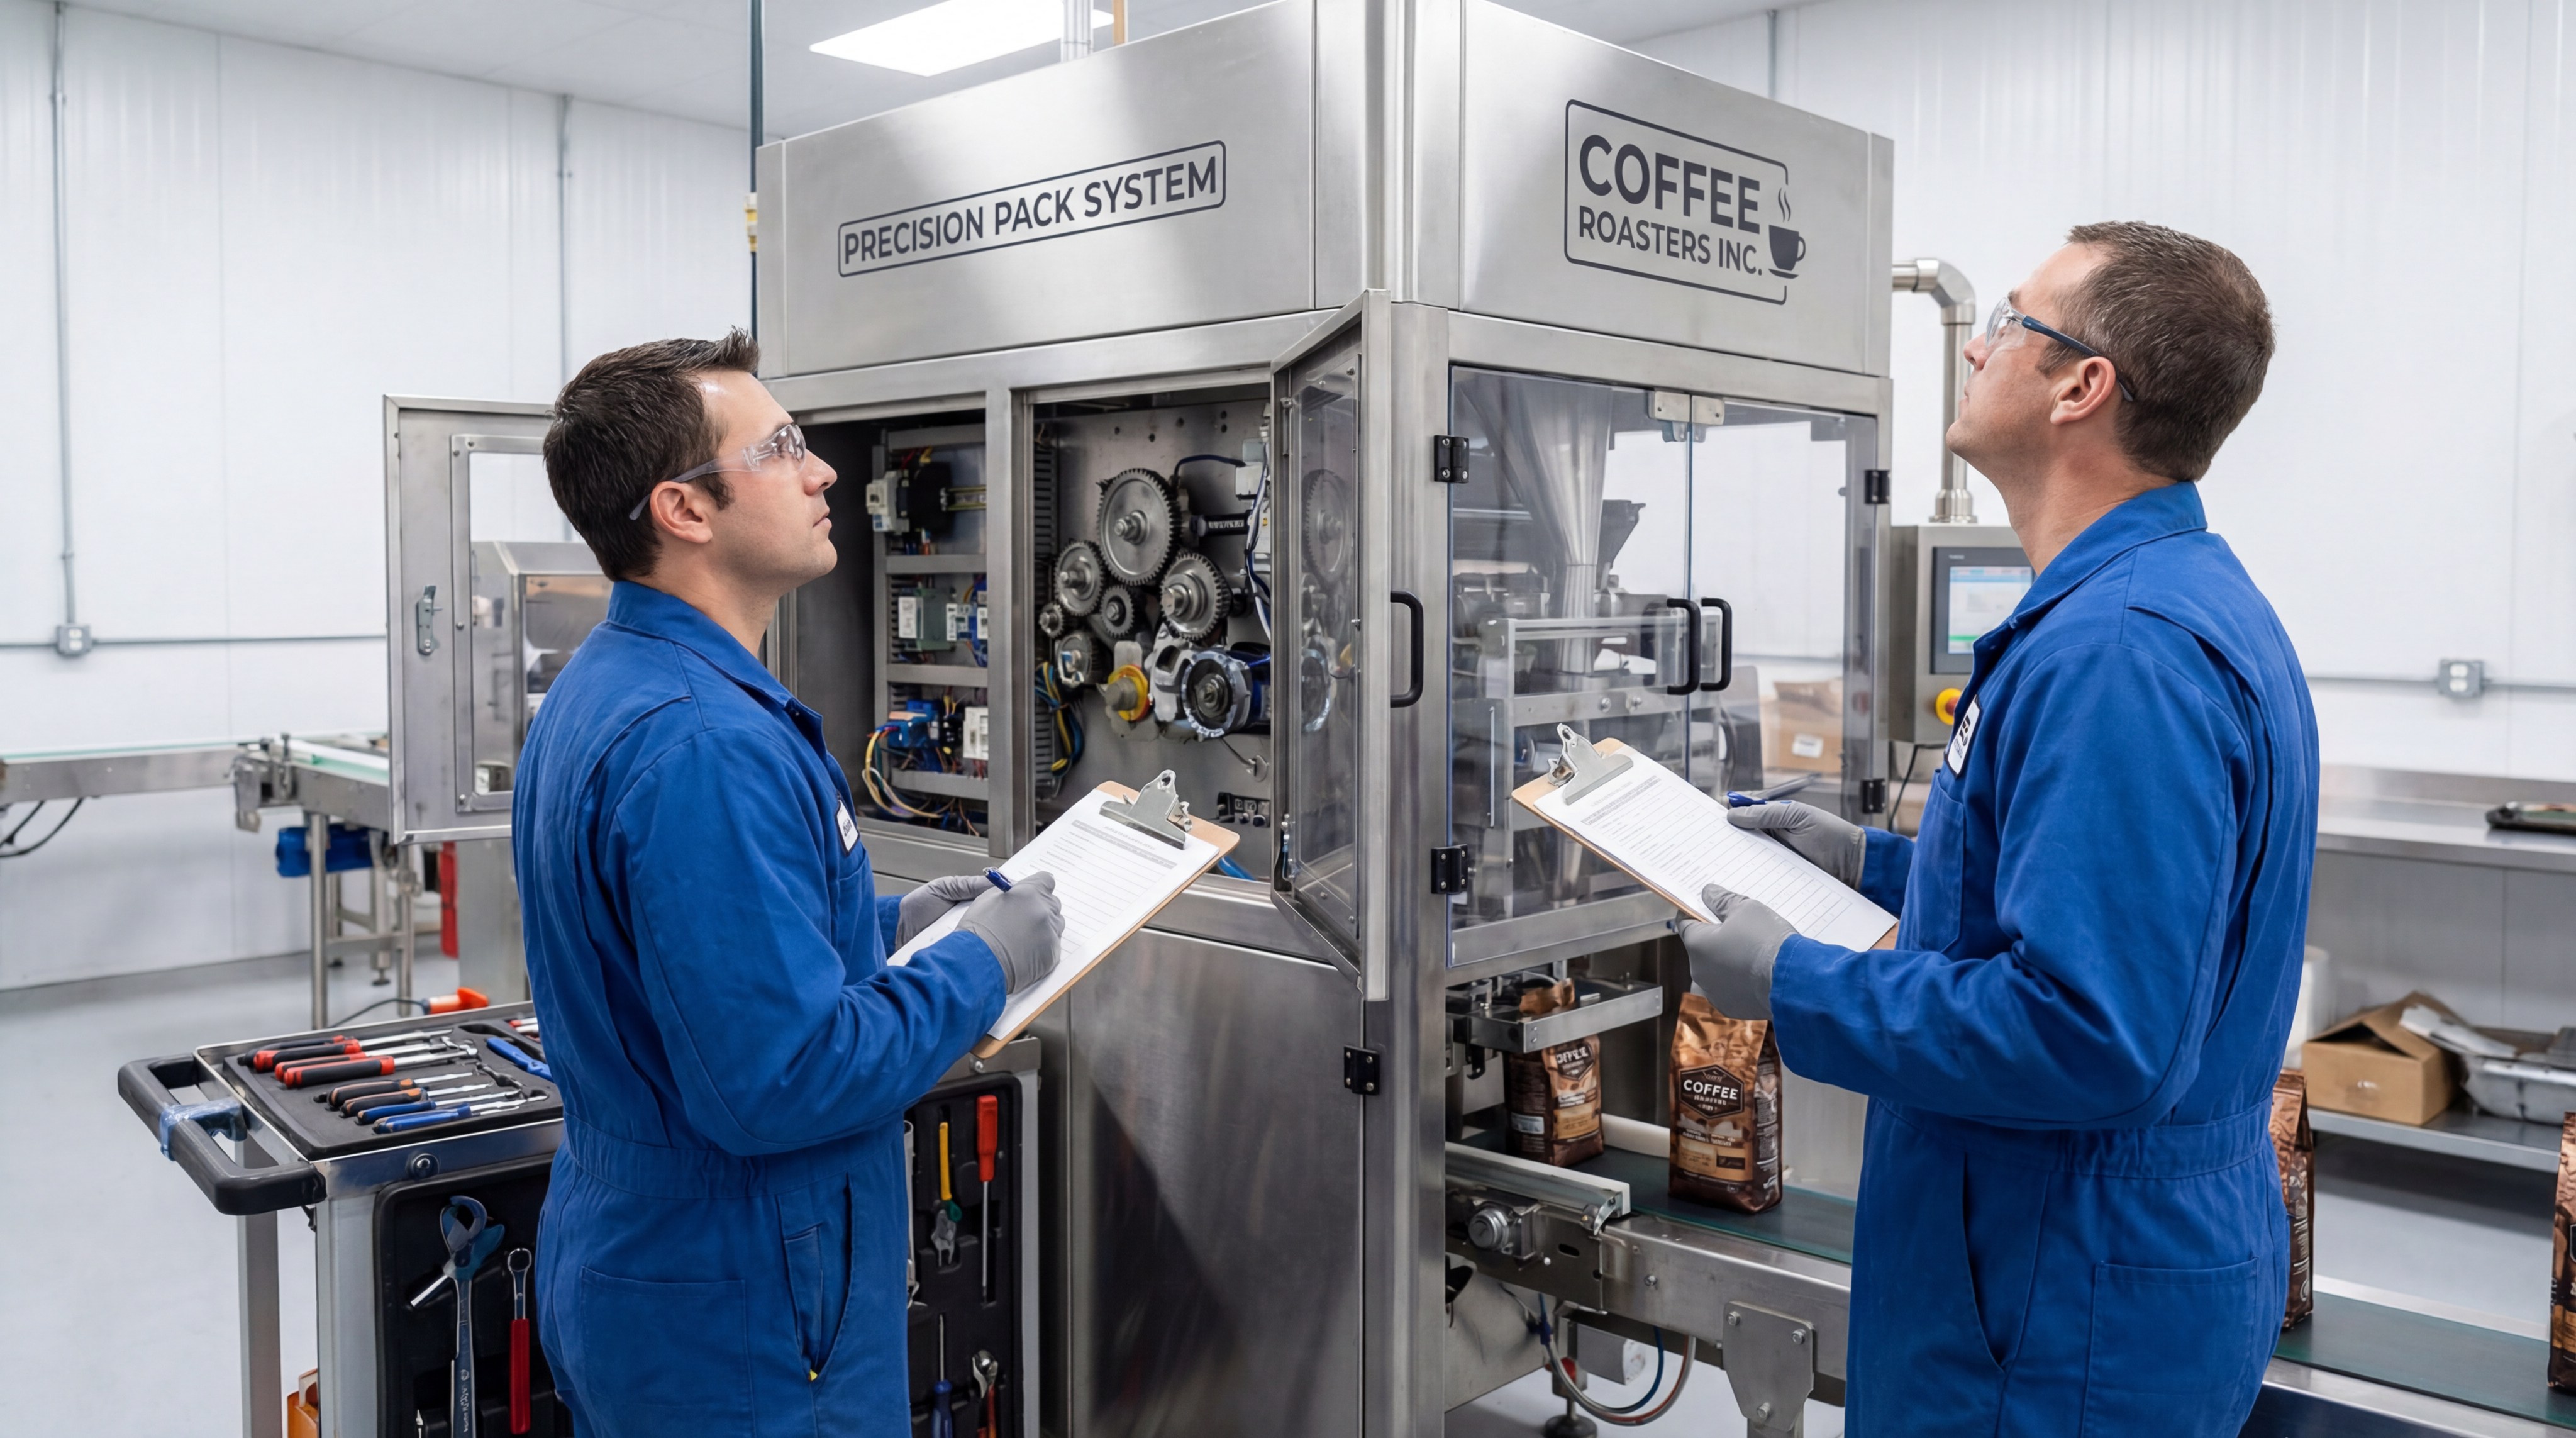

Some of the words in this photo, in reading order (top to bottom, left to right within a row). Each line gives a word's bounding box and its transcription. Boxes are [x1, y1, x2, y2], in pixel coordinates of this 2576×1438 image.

[845, 206, 983, 265] PRECISION
[995, 187, 1075, 235] PACK
[1084, 155, 1217, 218] SYSTEM
[1579, 134, 1760, 235] COFFEE
[1579, 205, 1711, 264] ROASTERS
[1719, 238, 1762, 276] INC.
[1683, 1079, 1739, 1100] COFFEE
